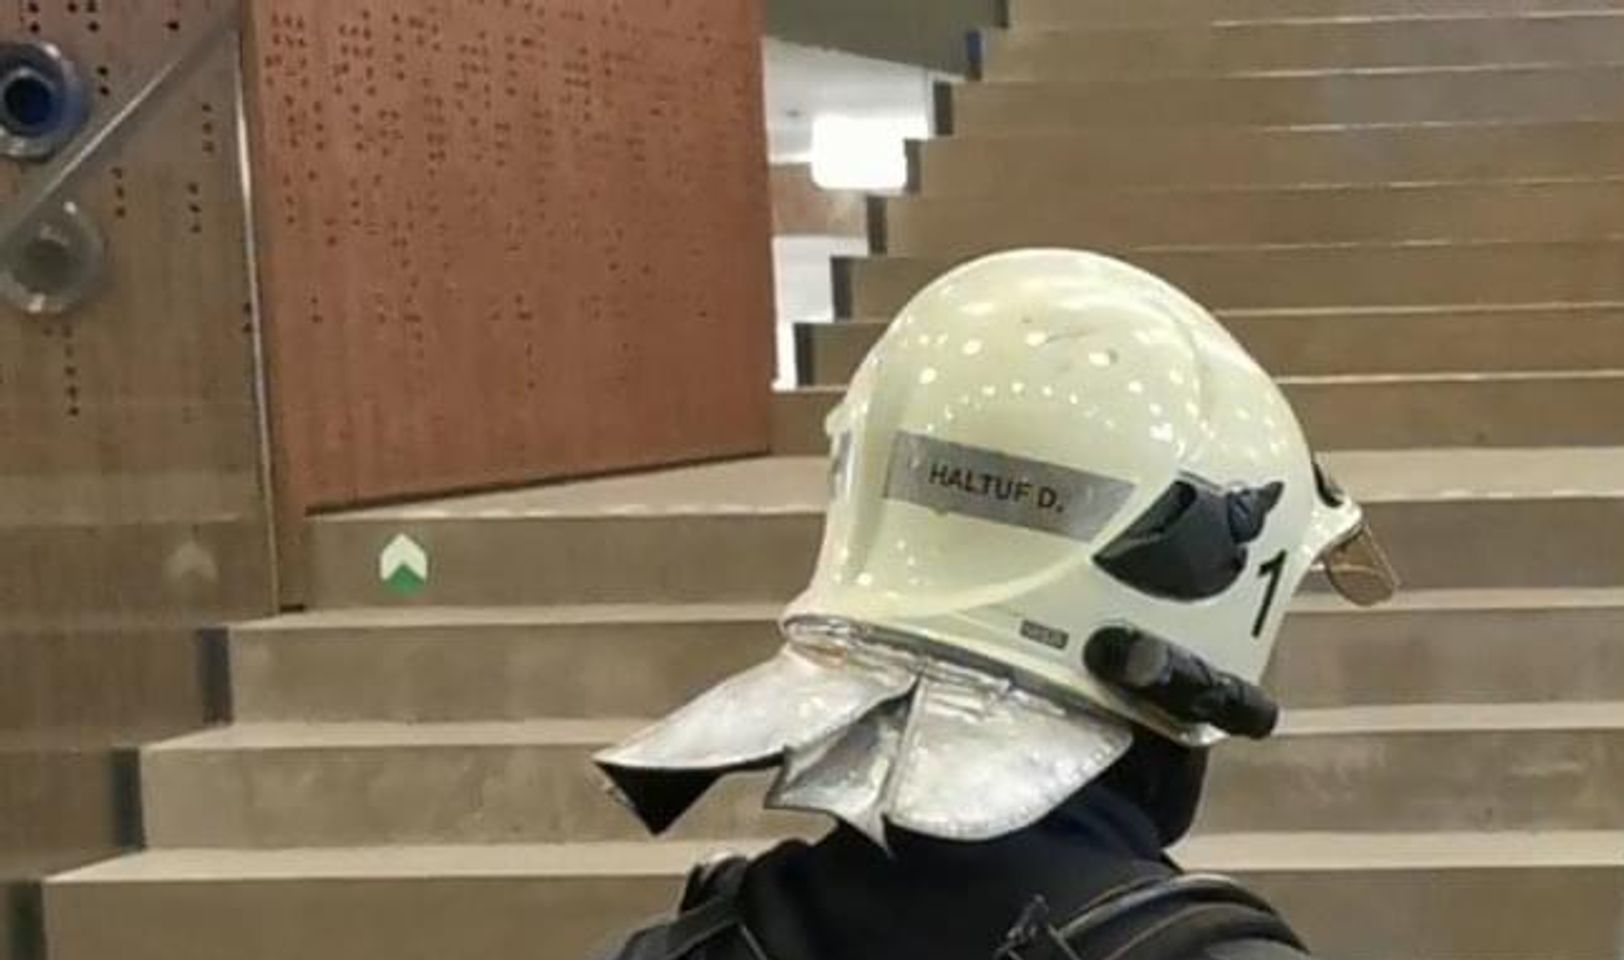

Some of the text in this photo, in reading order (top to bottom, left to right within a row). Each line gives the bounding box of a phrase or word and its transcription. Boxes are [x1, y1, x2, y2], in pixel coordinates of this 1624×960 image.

[928, 464, 1065, 513] HALTUF D.
[1253, 549, 1287, 638] 1
